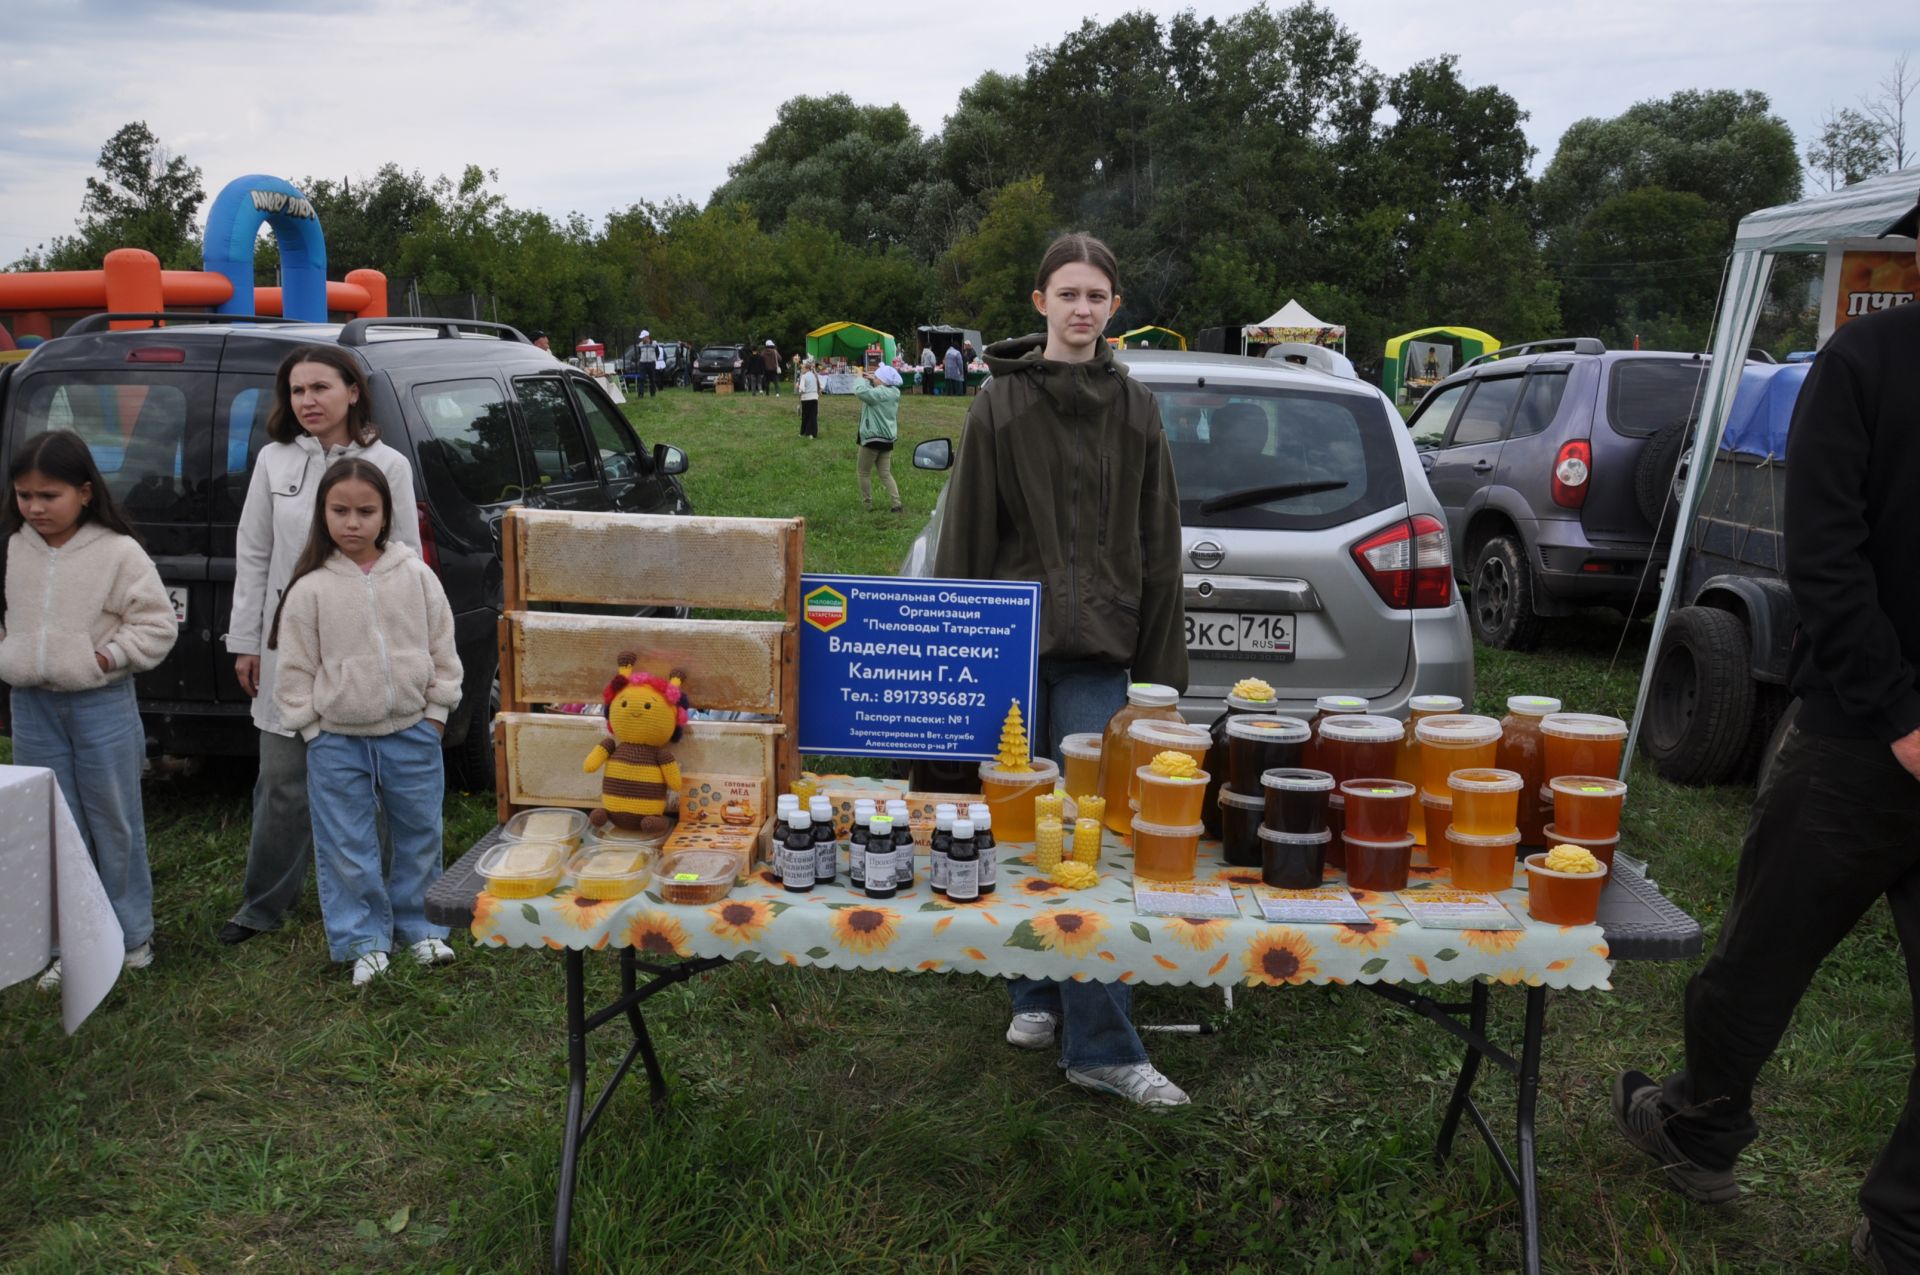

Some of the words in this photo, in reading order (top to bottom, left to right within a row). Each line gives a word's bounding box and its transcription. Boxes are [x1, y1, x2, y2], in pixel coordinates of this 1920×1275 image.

[251, 190, 287, 212] ANGRY
[851, 588, 935, 603] Региональная
[938, 591, 1031, 606] Общественная
[899, 605, 981, 619] Организация
[863, 618, 940, 633] "Пчеловоды
[943, 622, 1017, 636] Татарстана"
[1241, 617, 1285, 640] 716
[829, 636, 921, 658] Владелец
[926, 645, 1000, 659] пасеки:
[1252, 640, 1274, 649] RUS
[849, 662, 932, 682] Калинин
[938, 665, 953, 683] Г.
[958, 666, 979, 683] А.
[840, 687, 879, 703] Тел.:
[883, 689, 986, 707] 89173956872
[855, 711, 902, 724] Паспорт
[904, 714, 945, 725] пасеки:
[948, 714, 963, 724] №
[964, 715, 970, 725] 1
[849, 728, 919, 739] Зарегистрирован
[927, 731, 943, 740] Вет.
[944, 732, 975, 742] службе
[865, 739, 926, 750] Алексеевского
[927, 742, 945, 751] р-на
[947, 741, 958, 750] РТ
